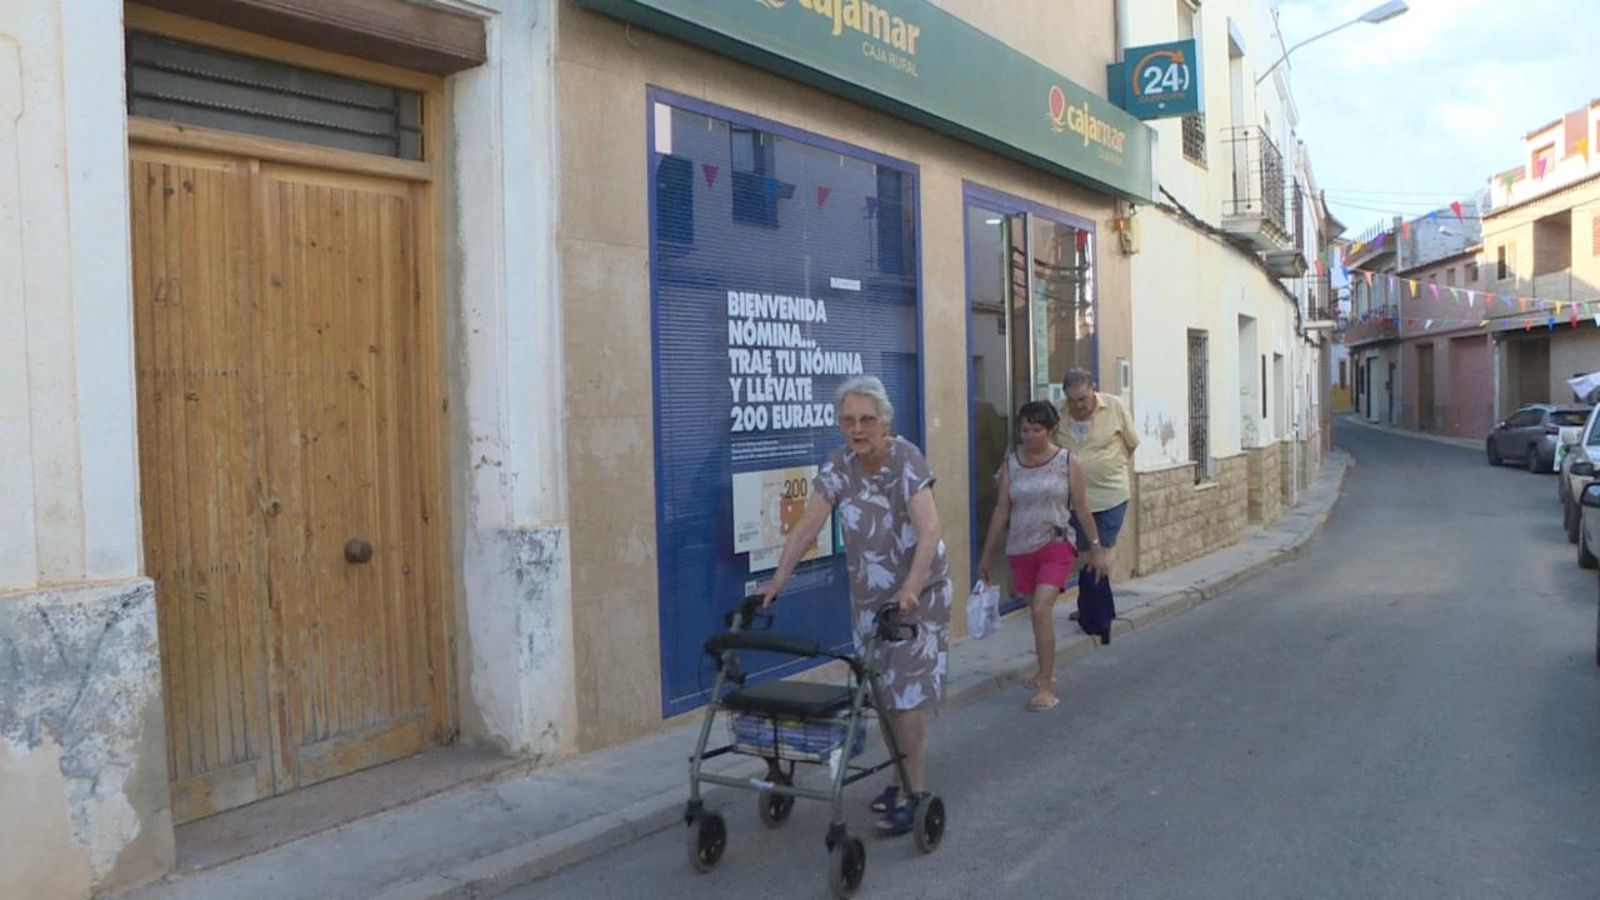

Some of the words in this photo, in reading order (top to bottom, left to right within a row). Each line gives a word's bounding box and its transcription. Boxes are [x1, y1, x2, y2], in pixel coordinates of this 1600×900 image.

[1067, 101, 1126, 153] cajamar
[727, 291, 826, 322] BIENVENIDA
[728, 316, 816, 347] NÓMINA...
[729, 349, 772, 374] TRAE
[776, 350, 796, 374] TU
[801, 348, 863, 374] NÓMINA
[729, 377, 743, 402] Y
[747, 374, 812, 402] LLÉVATE
[731, 405, 768, 431] 200
[772, 403, 838, 430] EURAZO
[784, 478, 808, 499] 200
